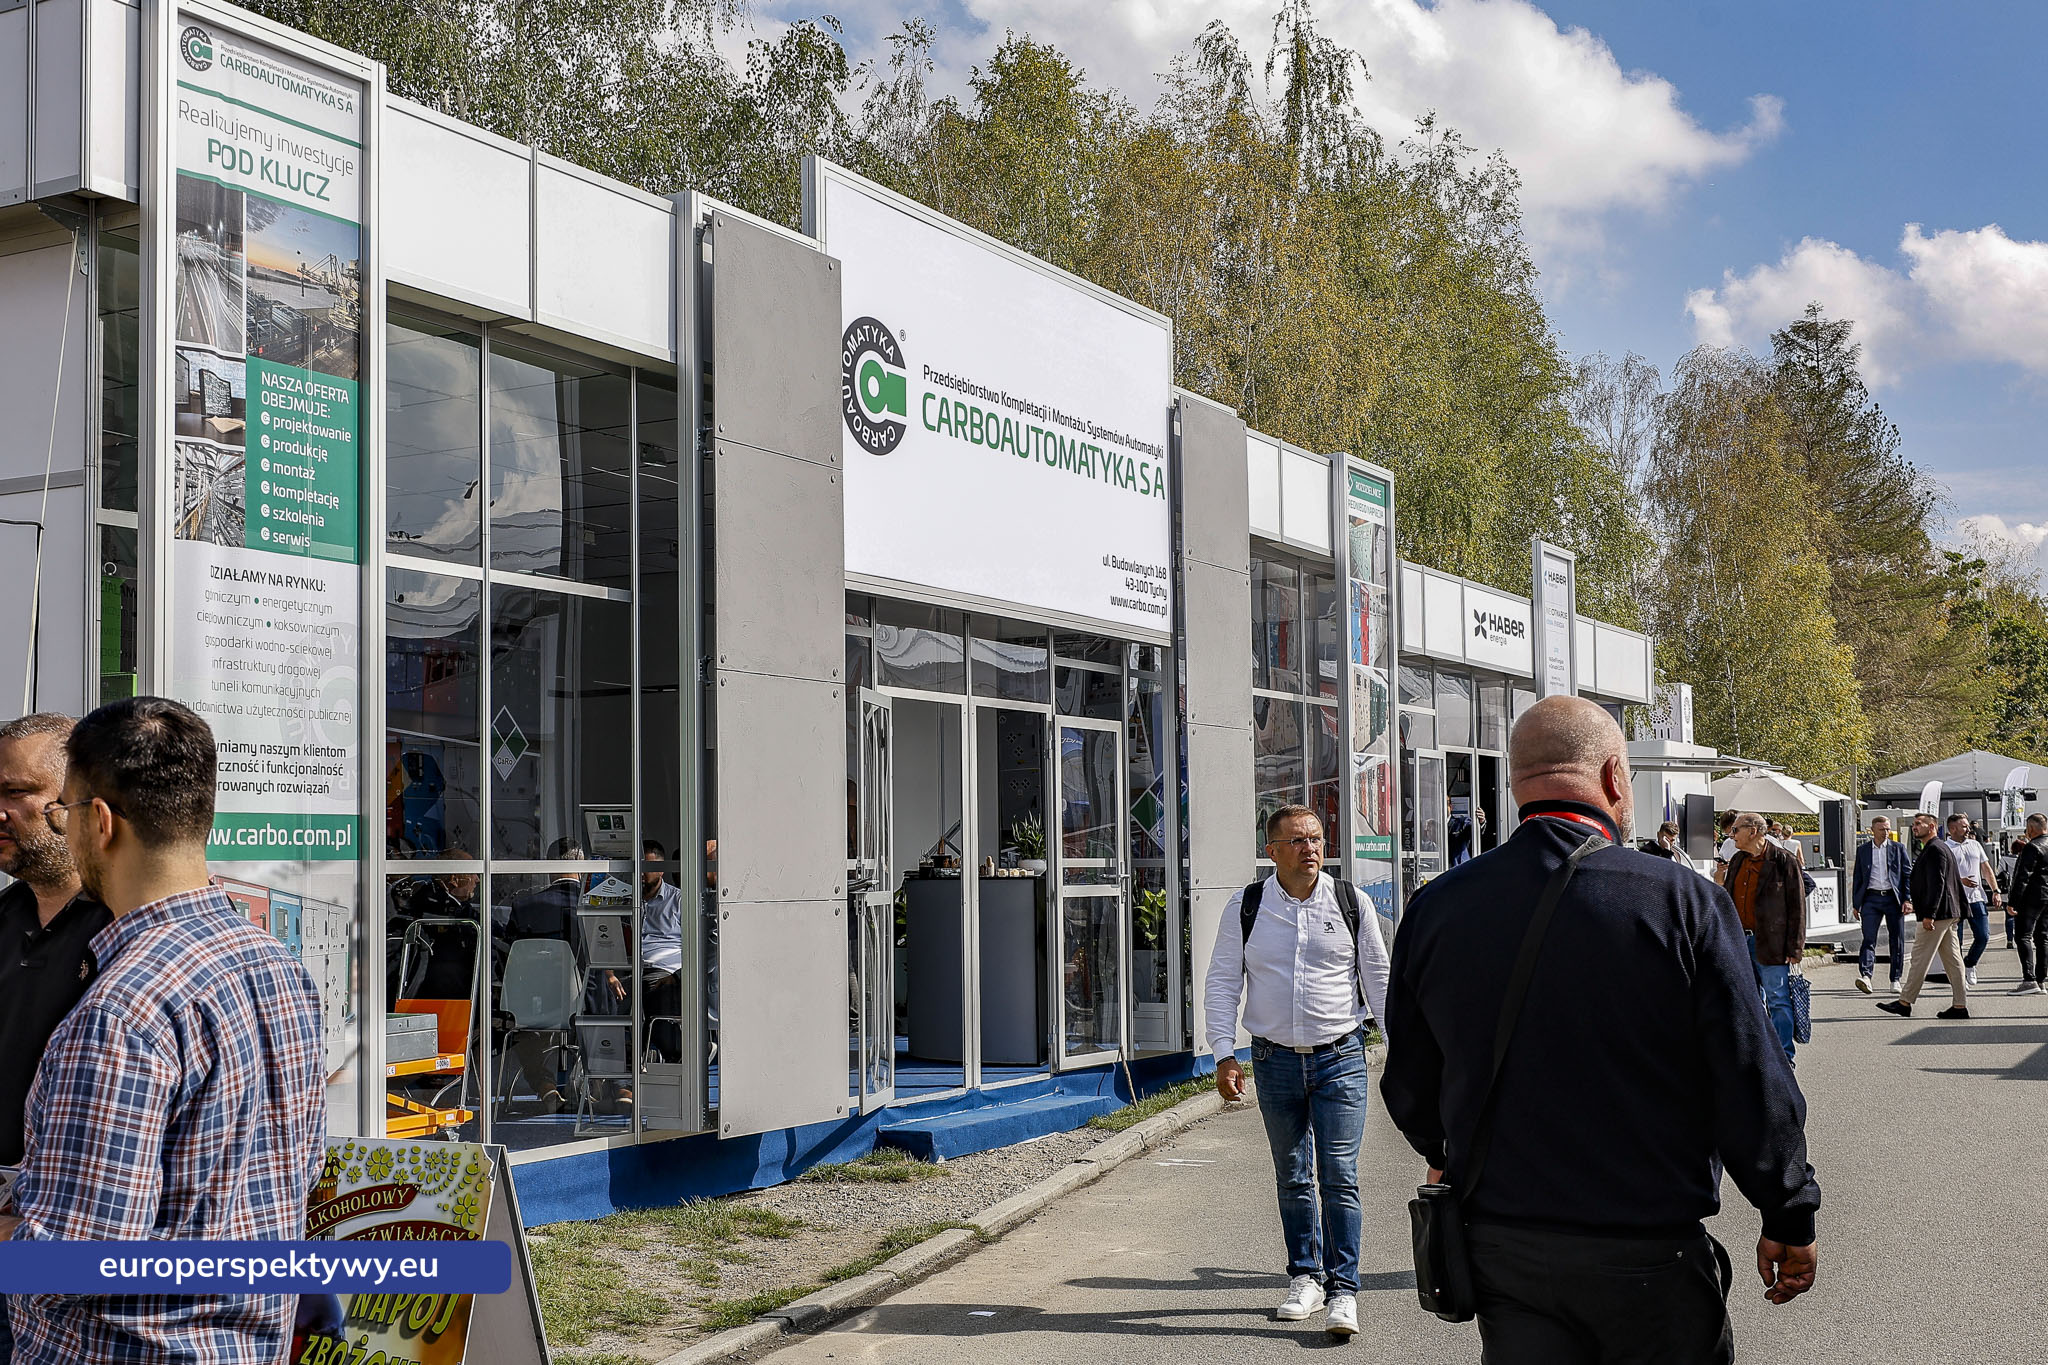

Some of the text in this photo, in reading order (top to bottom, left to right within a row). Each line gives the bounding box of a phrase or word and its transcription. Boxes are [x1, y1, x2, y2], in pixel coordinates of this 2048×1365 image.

[220, 53, 336, 109] CARBOAUTOMATYKA
[178, 99, 354, 177] Realizujemy inwestycje
[207, 137, 330, 202] POD KLUCZ
[261, 370, 350, 405] NASZA OFERTA
[261, 390, 331, 419] OBEJMUJE:
[922, 364, 1000, 404] Przedsiębiorstwo
[1000, 391, 1047, 422] Kompletacji
[1052, 408, 1086, 433] Montażu
[1087, 419, 1124, 446] Systemów
[1124, 433, 1164, 460] Automatyki
[273, 415, 352, 442] projektowanie
[273, 438, 328, 463] produkcję
[922, 391, 1137, 492] CARBOAUTOMATYKA
[272, 463, 316, 481] montaż
[272, 482, 340, 510] kompletację
[272, 507, 325, 527] szkolenia
[272, 531, 311, 548] serwis
[210, 564, 327, 593] DZIAŁAMY NA RYNKU:
[1102, 553, 1167, 580] ul. Budowlanych 168
[1125, 577, 1167, 600] 43-100 Tychy
[262, 596, 333, 616] energetycznym
[1110, 595, 1168, 619] www.carbo.com.pl
[204, 633, 253, 648] gospodarki
[273, 618, 340, 640] koksowniczym
[1489, 634, 1507, 646] energia
[211, 657, 321, 680] infrastruktury drogowej
[211, 679, 321, 700] tuneli komunikacyjnych
[246, 703, 306, 720] użyteczności
[308, 708, 352, 725] publicznej
[259, 743, 301, 759] naszym
[303, 743, 347, 758] klientom
[218, 760, 344, 777] czność i funkcjonalność
[217, 780, 330, 796] rowanych rozwiązań
[206, 822, 351, 851] w.carbo.com.pl
[305, 1187, 411, 1235] LKOHOLOWY
